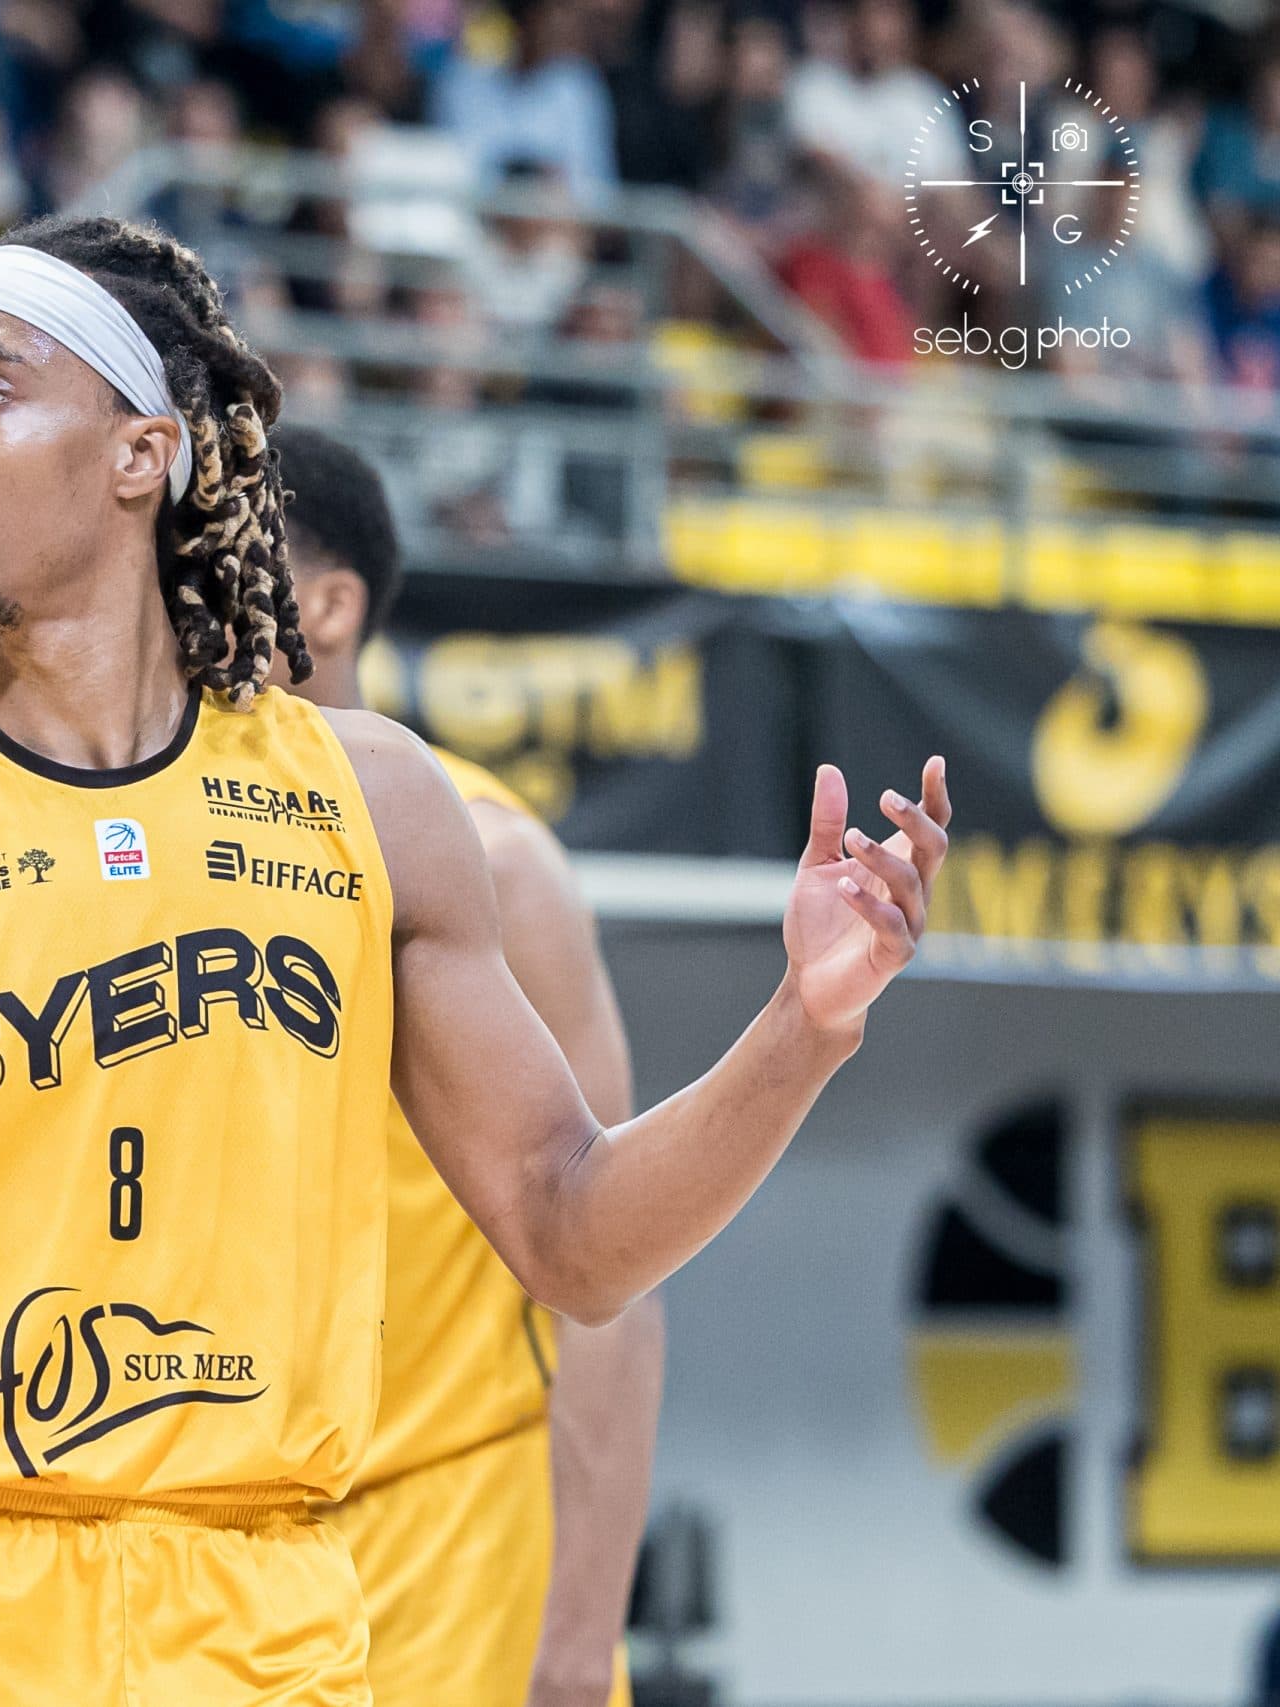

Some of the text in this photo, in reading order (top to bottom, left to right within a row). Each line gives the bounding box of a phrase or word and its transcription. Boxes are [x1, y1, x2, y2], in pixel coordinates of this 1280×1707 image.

[201, 776, 342, 819] HECTARE
[209, 807, 270, 823] URBANISME
[109, 865, 142, 876] ÉLITE
[251, 858, 365, 902] EIFFAGE
[109, 1126, 145, 1242] 8
[123, 1353, 186, 1382] SUR
[193, 1352, 257, 1382] MER
